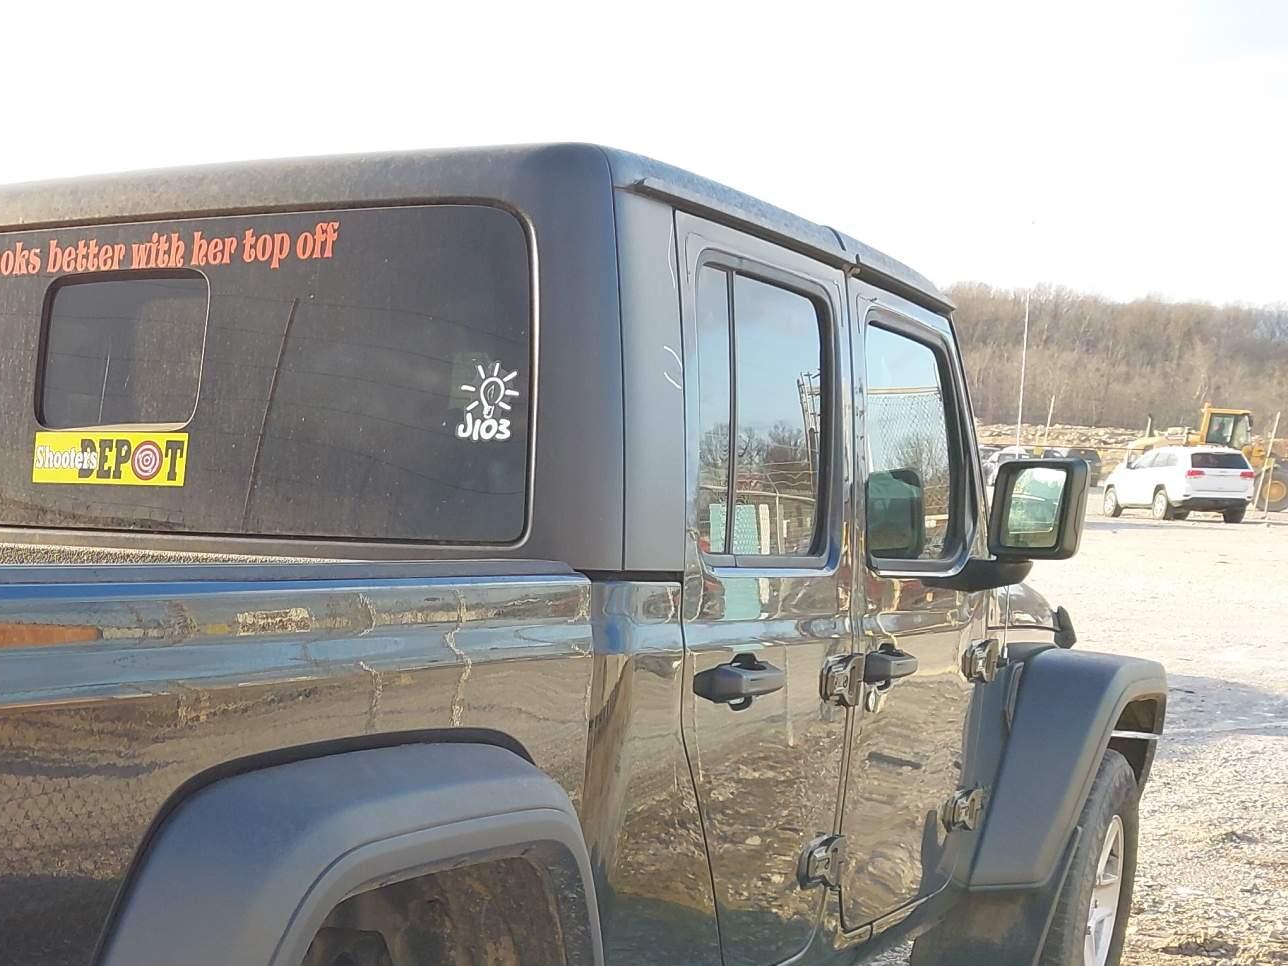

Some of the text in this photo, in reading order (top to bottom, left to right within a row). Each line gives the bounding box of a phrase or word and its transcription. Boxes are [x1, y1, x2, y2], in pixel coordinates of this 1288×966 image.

[47, 239, 126, 273] better
[130, 232, 185, 268] with
[189, 231, 238, 267] her
[242, 228, 291, 269] top
[296, 221, 340, 260] off
